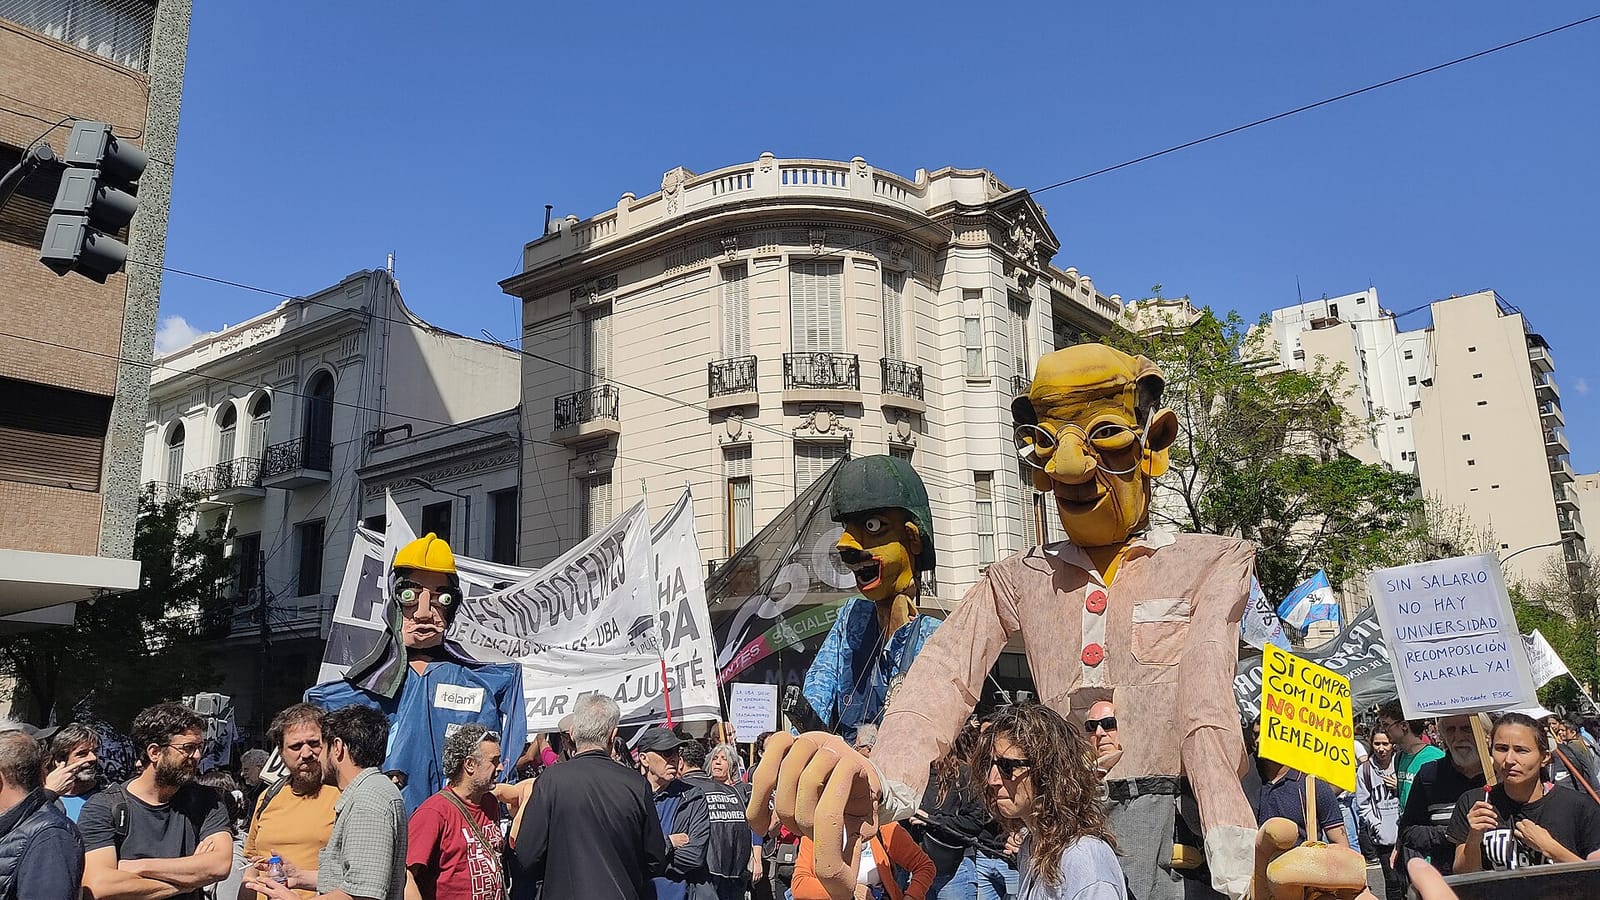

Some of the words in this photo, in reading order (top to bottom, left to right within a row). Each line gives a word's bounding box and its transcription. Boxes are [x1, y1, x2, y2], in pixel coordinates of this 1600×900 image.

[1386, 577, 1411, 592] SIN
[1421, 571, 1487, 589] SALARIO
[1399, 601, 1421, 615] NO
[1434, 596, 1466, 611] HAY
[596, 617, 620, 646] UBA
[1396, 617, 1498, 640] UNIVERSIDAD
[1301, 667, 1351, 698] COMPRO
[1414, 664, 1478, 682] SALARIAL
[1485, 658, 1510, 672] YA!
[1269, 675, 1344, 718] COMIDA
[1267, 693, 1295, 720] NO
[1300, 707, 1352, 738] COMPRO
[1268, 716, 1350, 766] REMEDIOS
